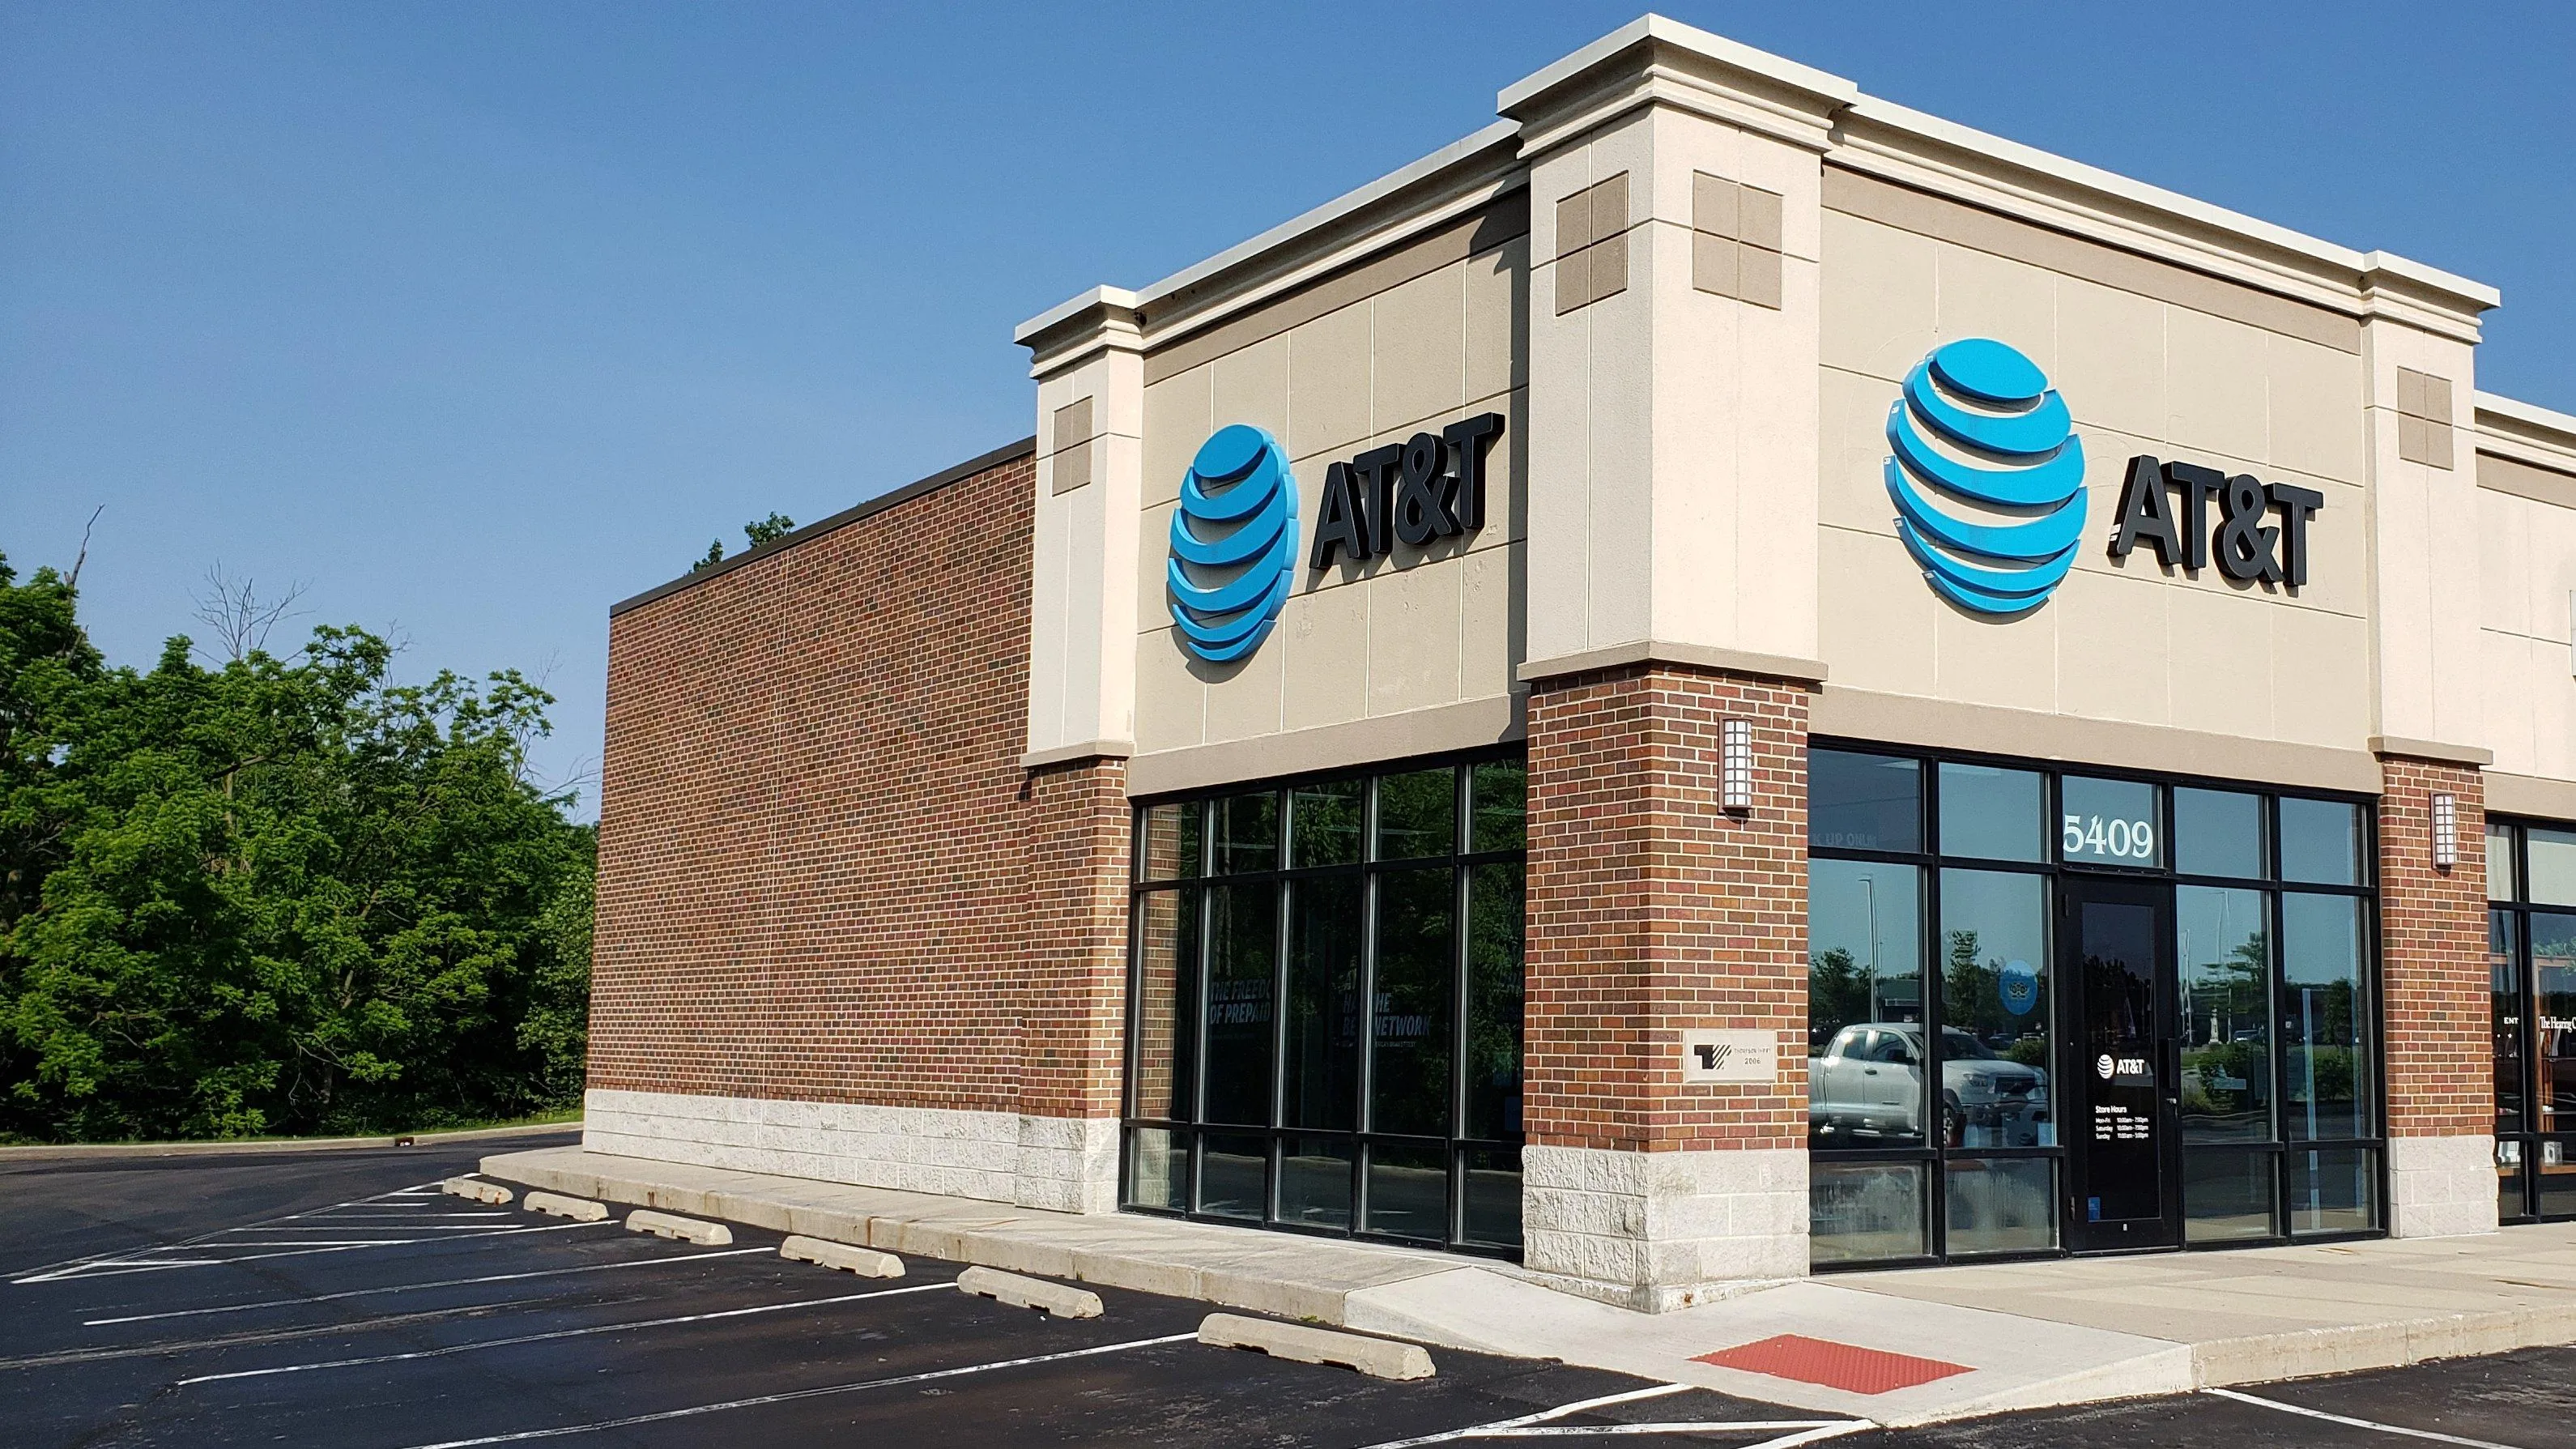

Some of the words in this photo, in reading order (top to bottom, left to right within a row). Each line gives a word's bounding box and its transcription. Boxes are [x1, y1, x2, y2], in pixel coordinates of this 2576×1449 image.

[1309, 411, 1505, 570] AT&T
[2106, 454, 2323, 586] AT&T
[2063, 814, 2153, 859] 5409
[1211, 981, 1230, 1002] THE
[1210, 1004, 1224, 1025] OF
[1224, 1001, 1271, 1024] PREPAID
[2503, 1016, 2519, 1025] ENT
[2540, 1016, 2551, 1029] The
[1744, 1057, 1761, 1065] 2006
[2116, 1059, 2145, 1075] AT&T
[2095, 1105, 2110, 1114] Store
[2110, 1105, 2127, 1114] Hours
